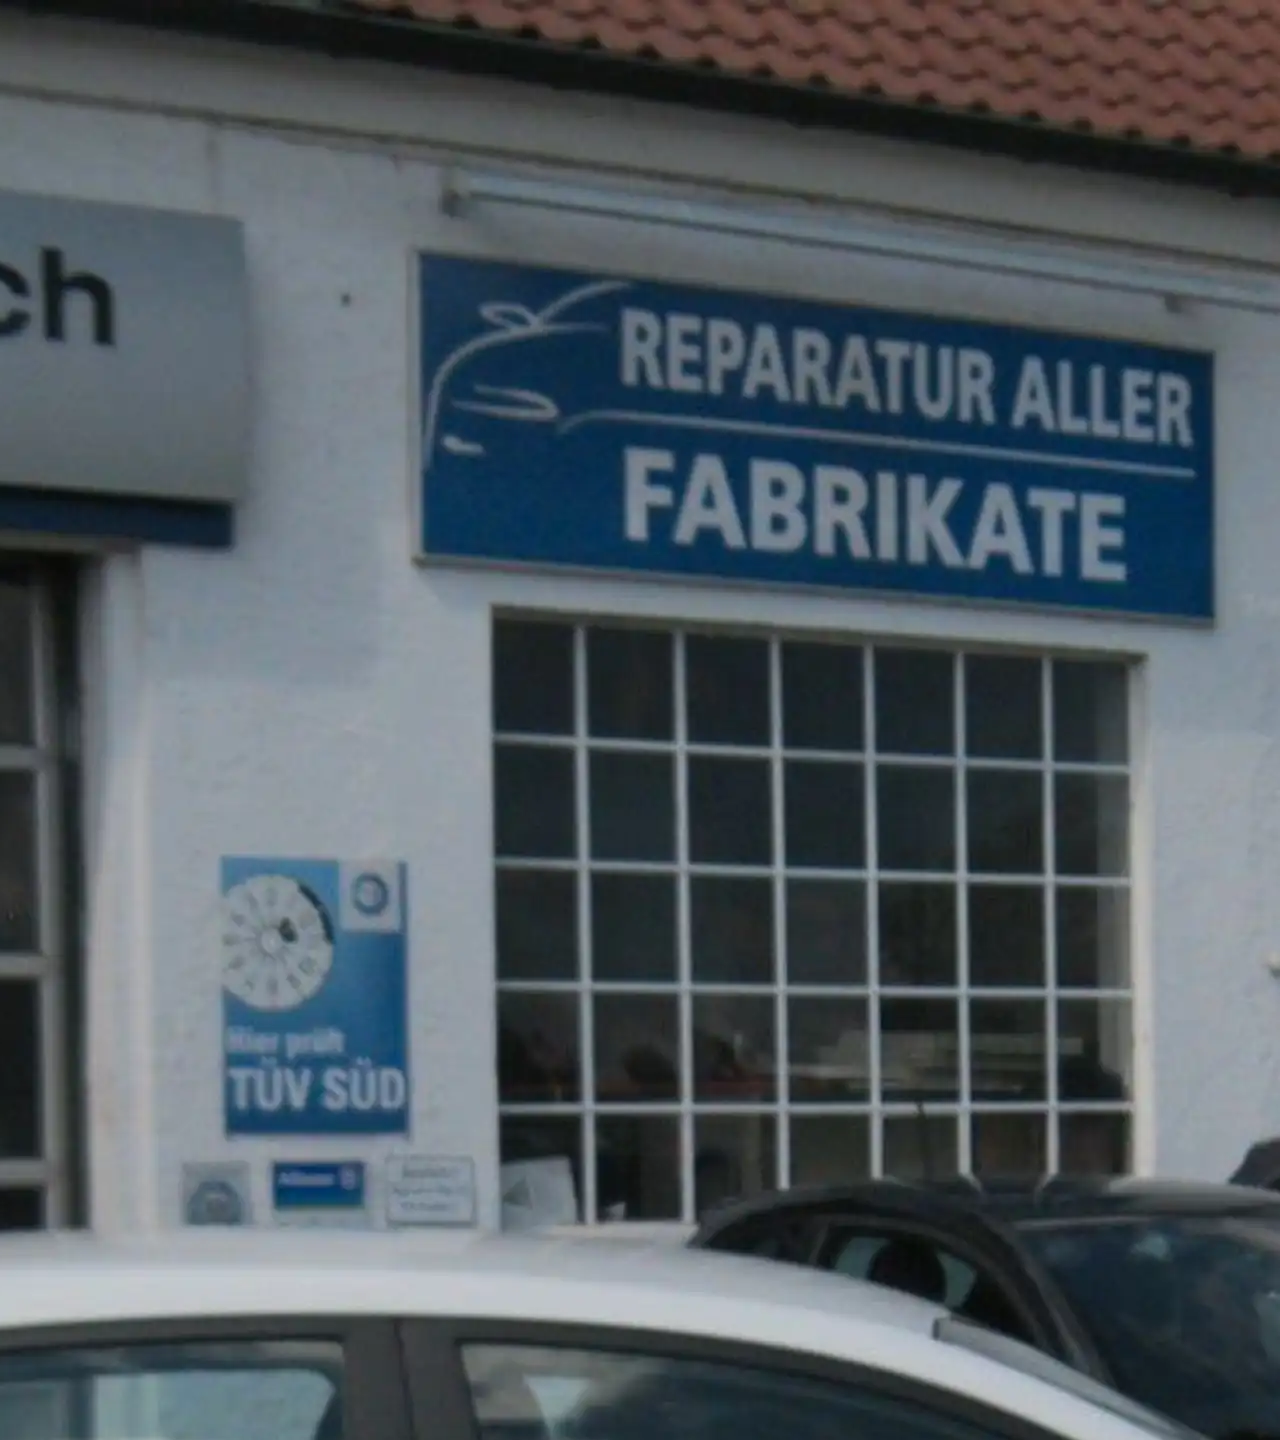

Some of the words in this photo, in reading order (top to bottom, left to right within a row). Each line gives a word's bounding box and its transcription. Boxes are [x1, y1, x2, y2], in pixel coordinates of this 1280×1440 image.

[619, 306, 996, 427] REPARATUR
[1011, 355, 1195, 448] ALLER
[622, 446, 1129, 583] FABRIKATE
[227, 1055, 314, 1111] TÜV
[321, 1055, 408, 1111] SÜD
